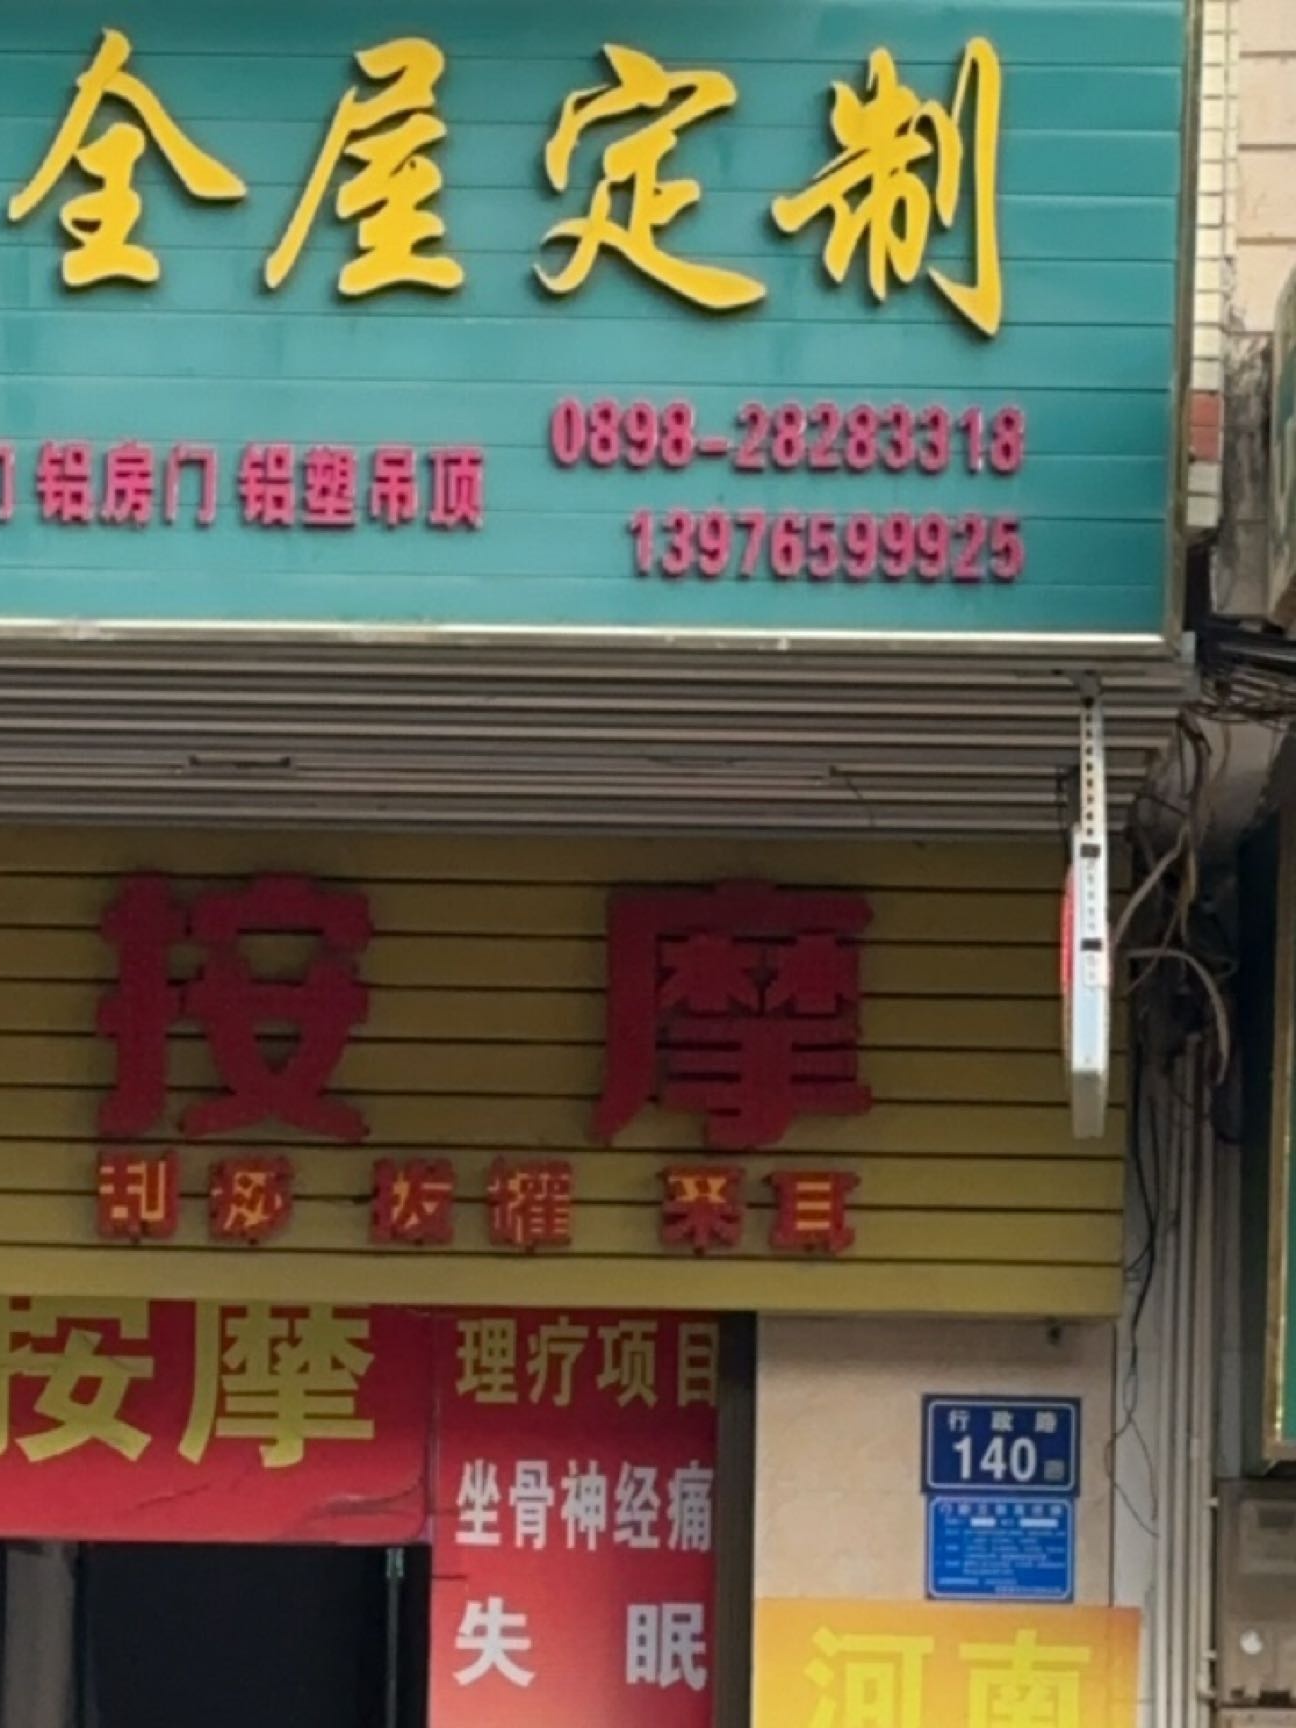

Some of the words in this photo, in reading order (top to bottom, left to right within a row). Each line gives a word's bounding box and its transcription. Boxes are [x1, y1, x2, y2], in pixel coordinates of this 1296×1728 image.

[8, 29, 1003, 336] 全屋定制
[551, 397, 1025, 474] 0898-28283318
[37, 439, 217, 527] 铝房门
[239, 442, 486, 530] 铝塑吊顶
[628, 510, 1025, 582] 13976599925
[456, 1316, 720, 1408] 理疗项目
[455, 1458, 714, 1553] 坐骨神经痛
[453, 1596, 707, 1691] 失眠
